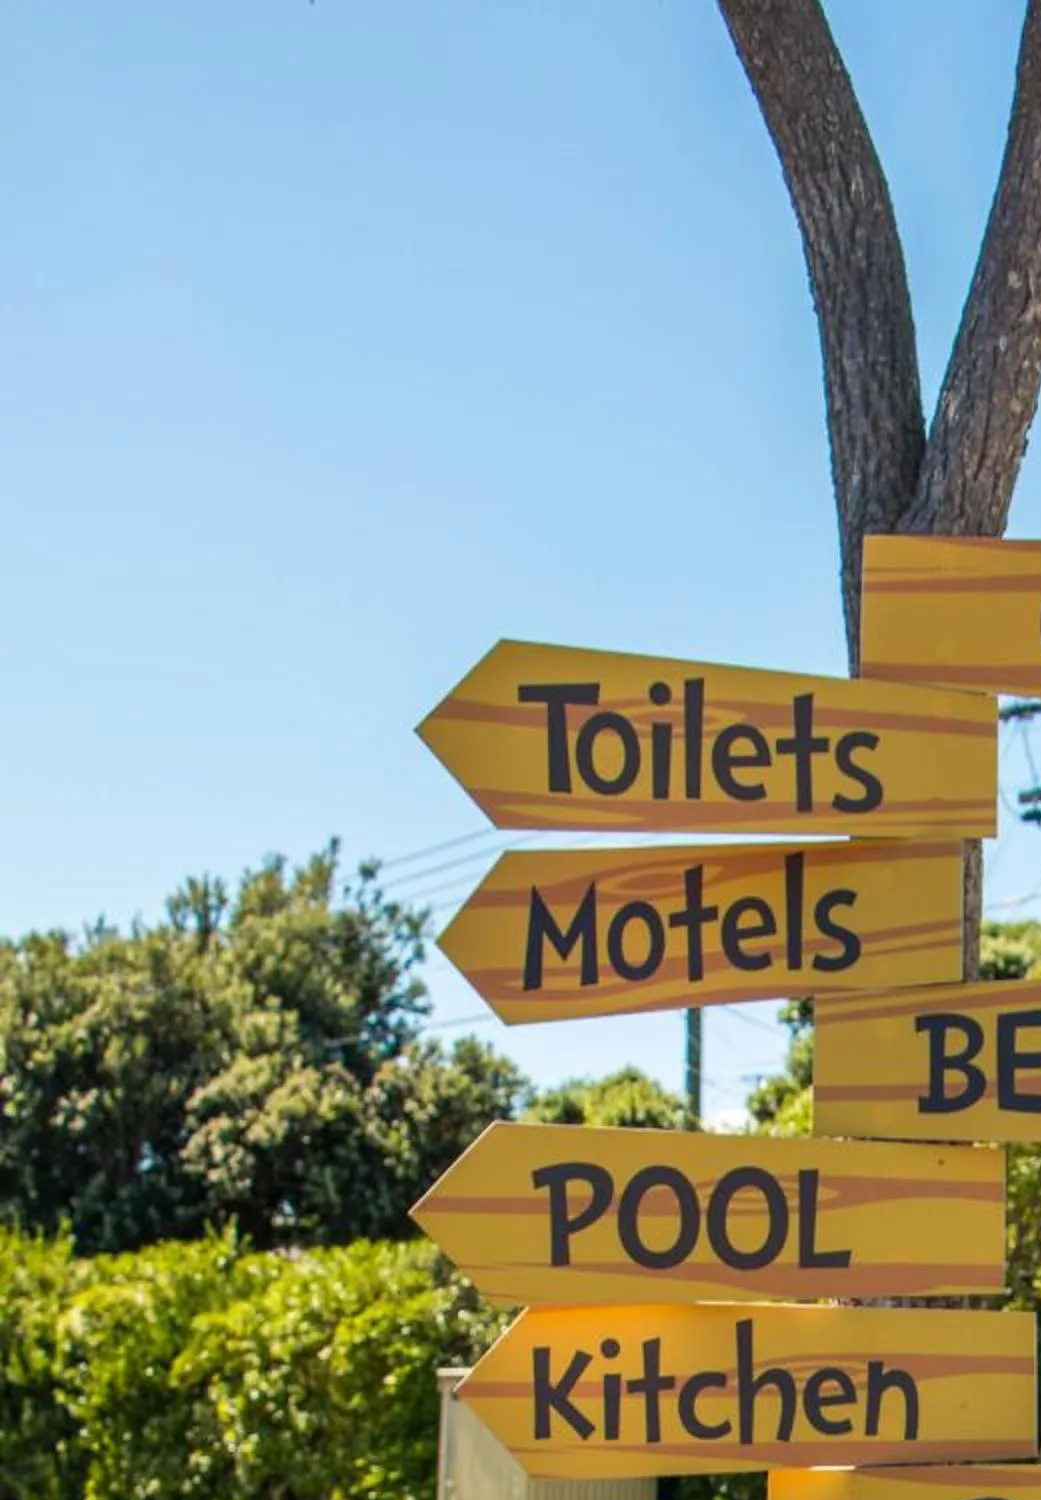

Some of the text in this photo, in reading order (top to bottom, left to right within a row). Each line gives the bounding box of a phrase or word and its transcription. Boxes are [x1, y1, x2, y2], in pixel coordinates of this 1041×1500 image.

[517, 677, 884, 813] Toilets
[522, 851, 862, 991] Motels
[532, 1164, 852, 1270] POOL
[533, 1320, 919, 1445] Kitchen
